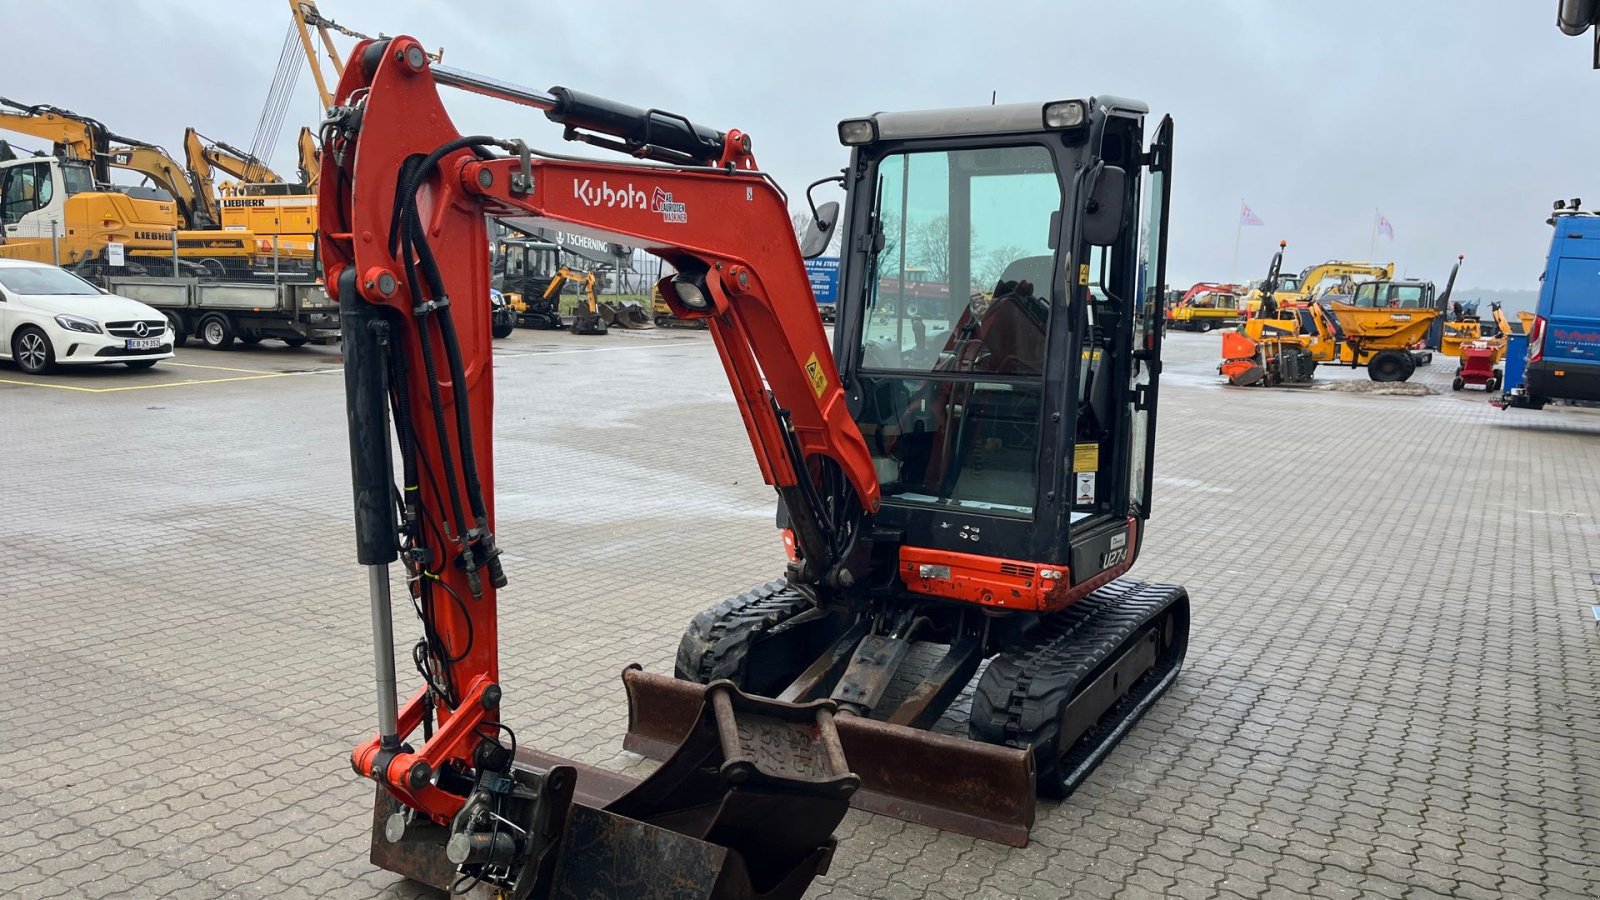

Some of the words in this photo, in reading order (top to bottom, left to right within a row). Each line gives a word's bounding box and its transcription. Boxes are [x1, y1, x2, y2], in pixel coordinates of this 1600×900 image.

[116, 154, 128, 165] CAT
[573, 178, 647, 209] Kubota
[223, 199, 265, 207] LIEBHERR
[566, 232, 608, 253] TSCHERNING
[132, 340, 141, 348] EB
